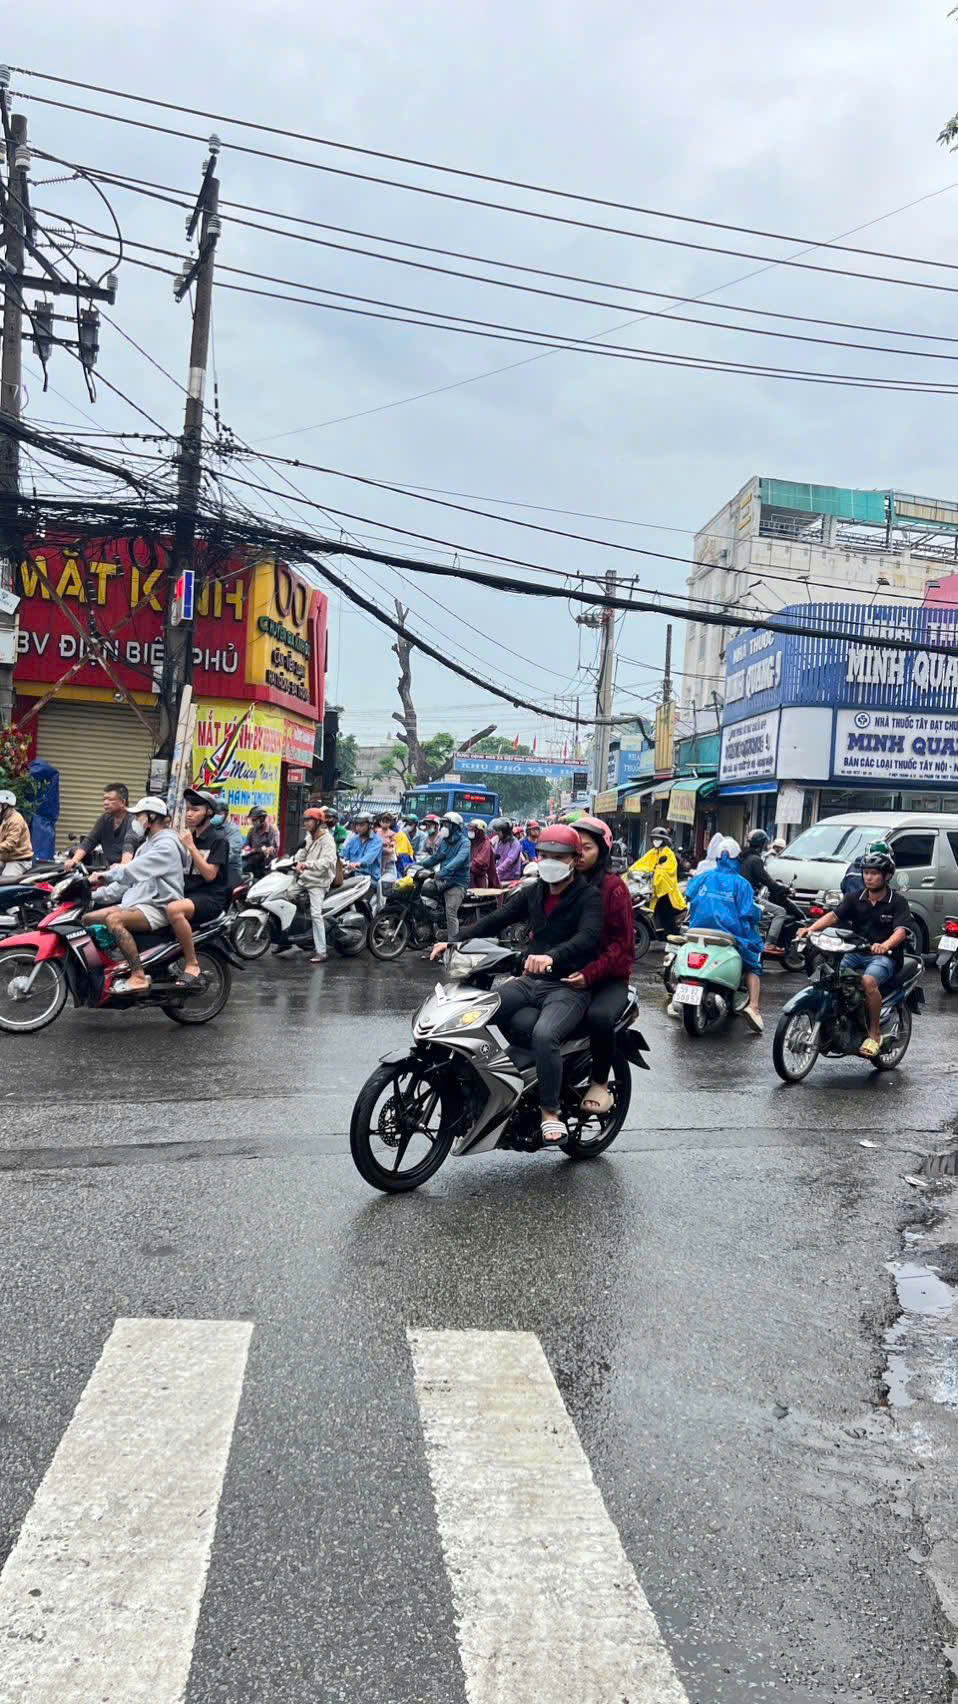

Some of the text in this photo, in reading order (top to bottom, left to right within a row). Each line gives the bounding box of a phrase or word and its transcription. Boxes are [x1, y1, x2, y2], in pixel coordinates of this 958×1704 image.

[126, 636, 166, 665] BIÊ
[846, 648, 905, 685] MINH
[875, 716, 889, 727] NHÀ
[892, 715, 914, 728] THUỐC
[915, 717, 928, 729] TÂY
[847, 732, 906, 752] MINH
[844, 756, 859, 767] BÁN
[860, 756, 874, 768] CÁC
[876, 759, 893, 770] LOẠI
[894, 757, 917, 769] THUỐC
[919, 758, 933, 770] TÂY
